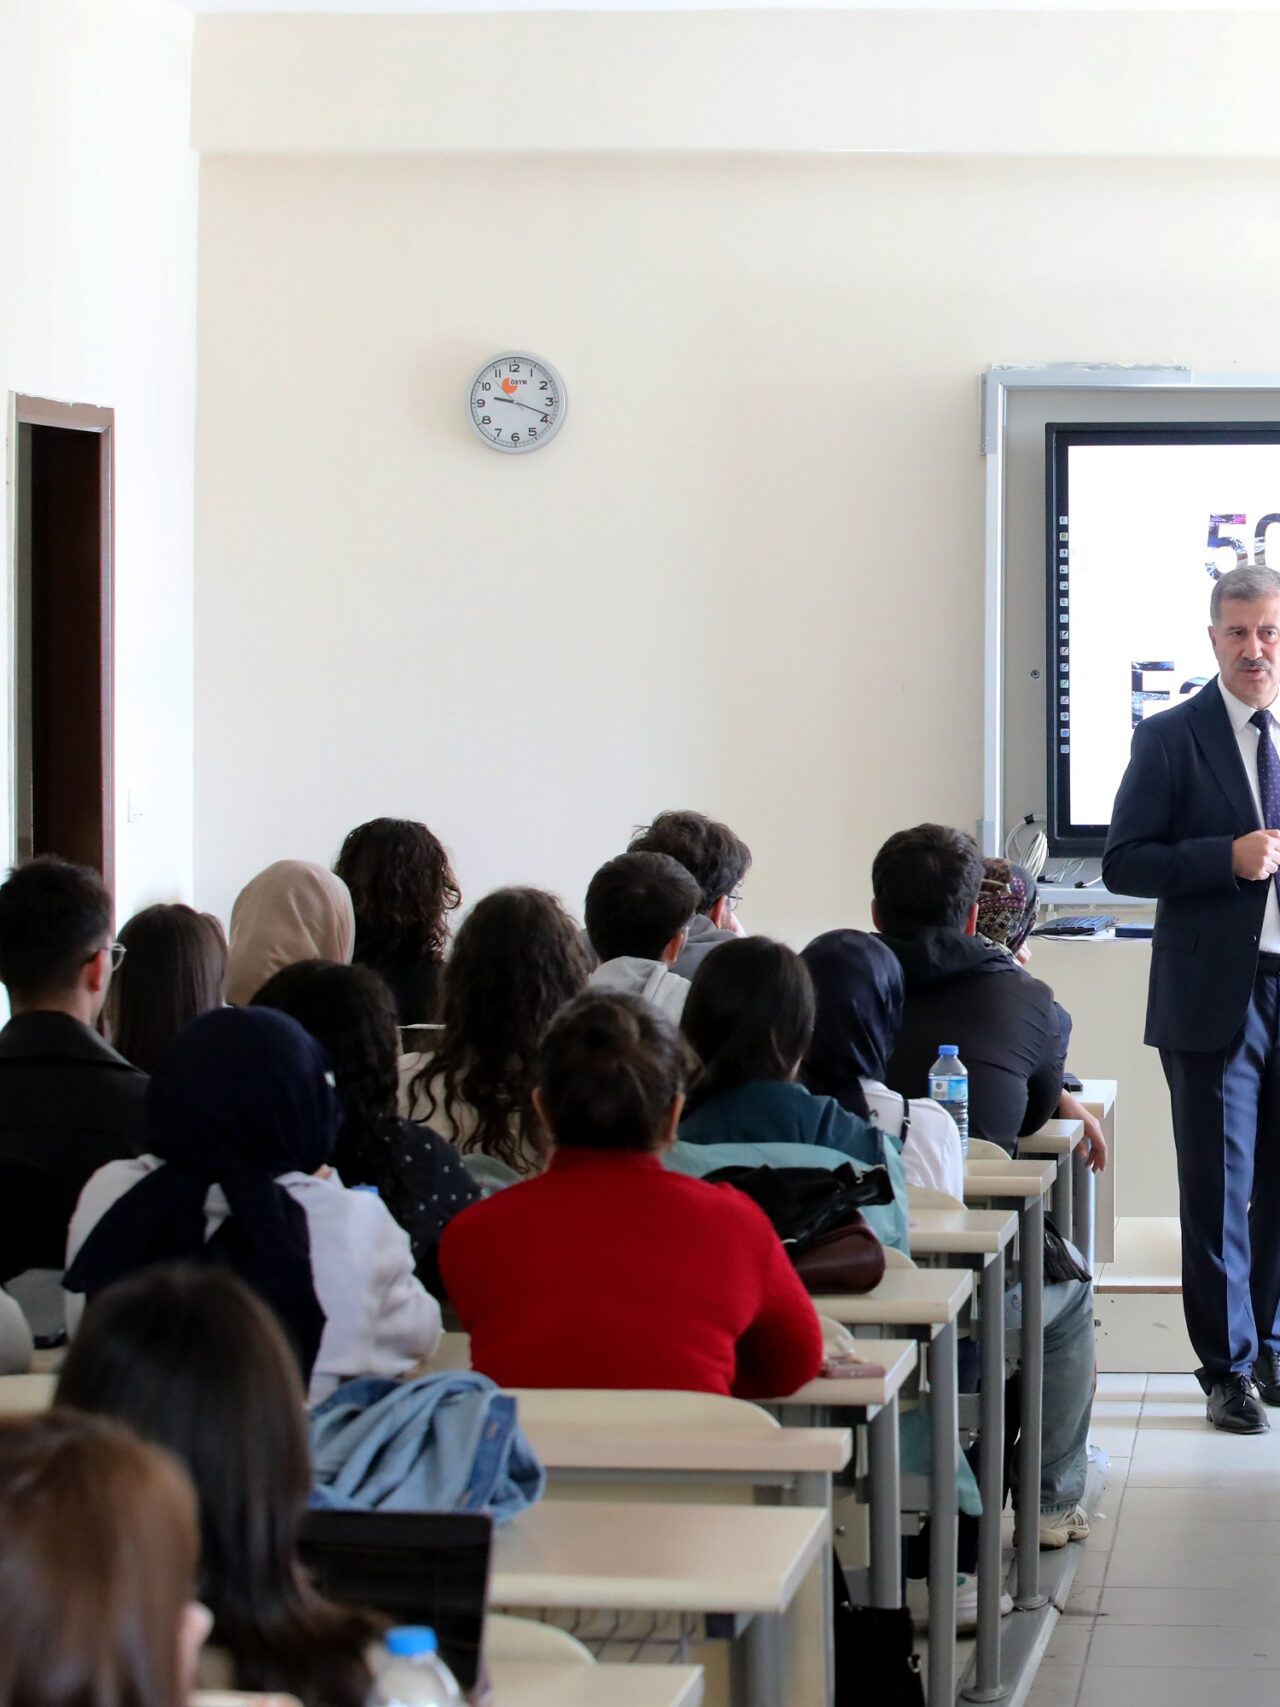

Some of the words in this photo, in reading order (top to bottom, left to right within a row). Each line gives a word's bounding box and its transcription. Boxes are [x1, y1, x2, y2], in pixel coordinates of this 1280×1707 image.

[509, 363, 520, 373] 12
[494, 369, 502, 378] 11
[481, 382, 491, 391] 10
[539, 381, 548, 390] 2
[476, 398, 486, 408] 9
[544, 397, 554, 407] 3
[481, 415, 492, 425] 8
[540, 414, 549, 424] 4
[494, 428, 503, 438] 7
[510, 432, 520, 442] 6
[528, 427, 538, 437] 5
